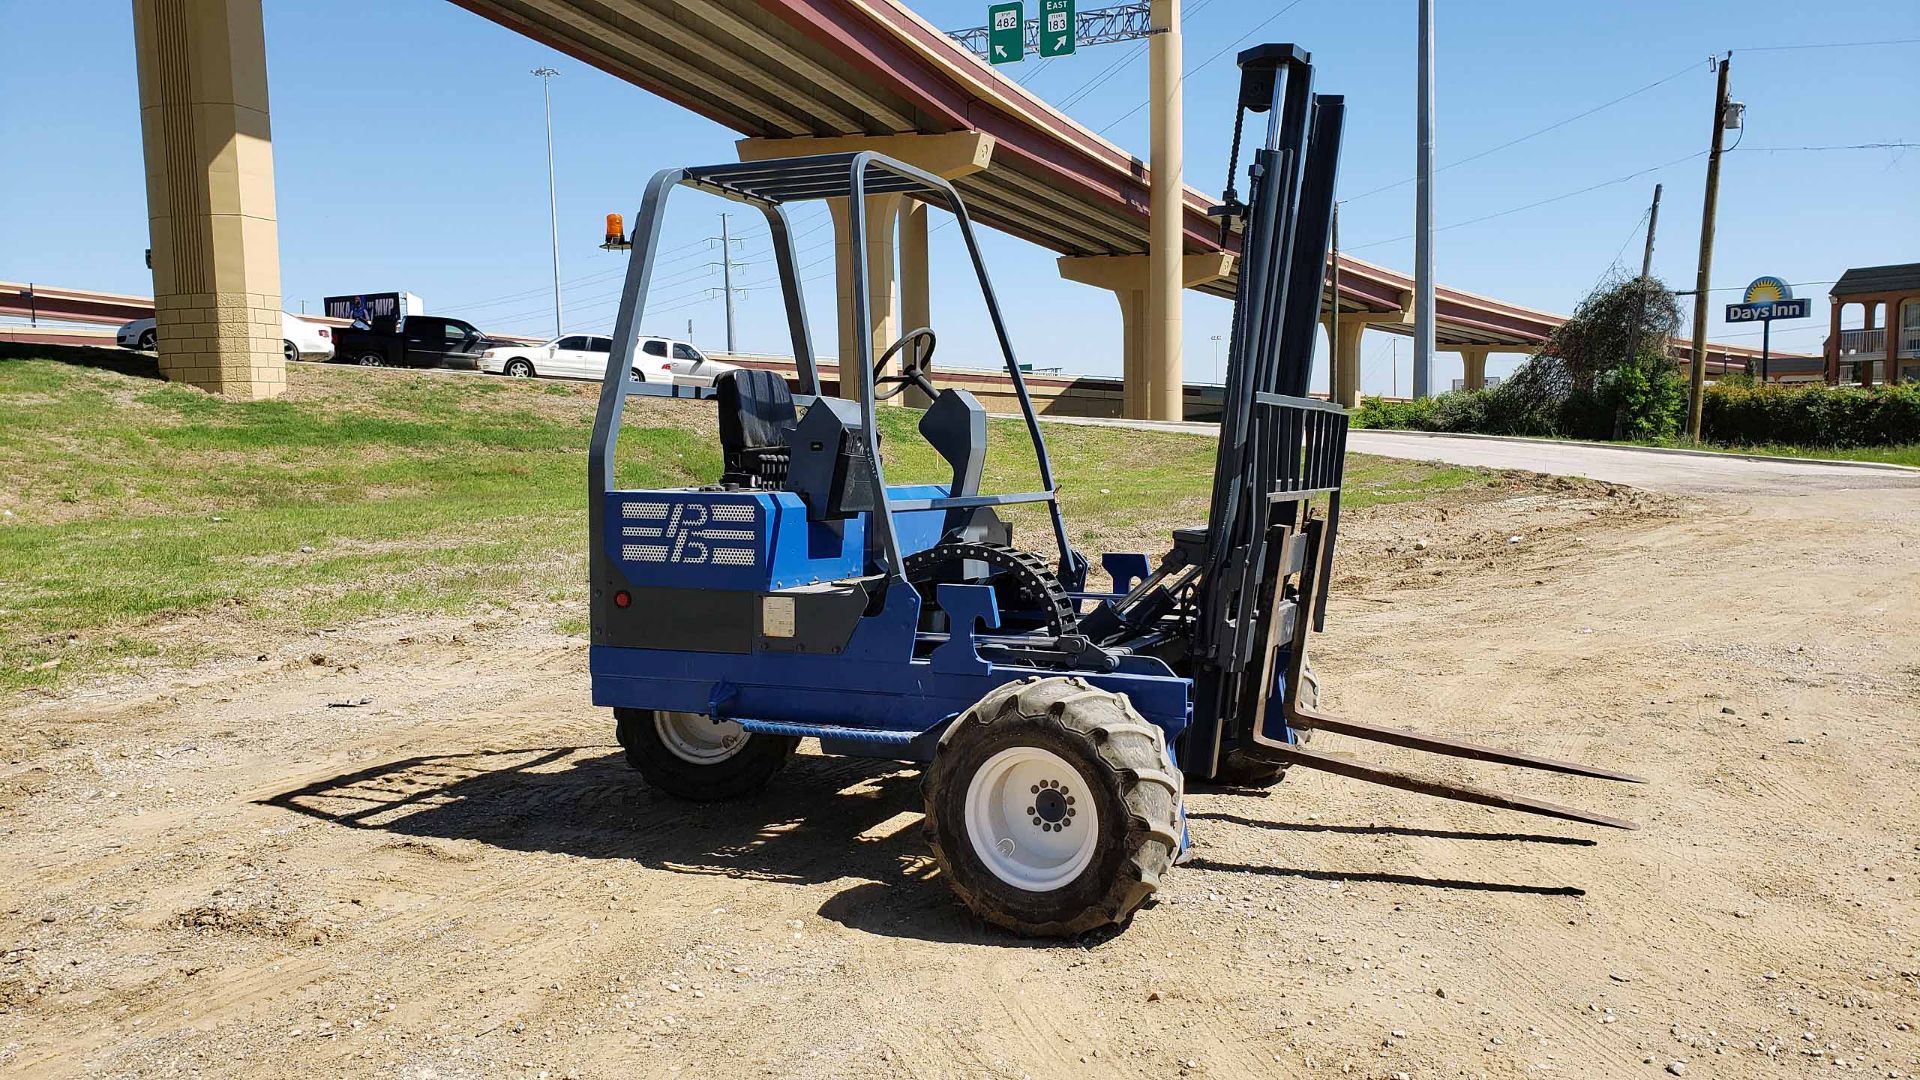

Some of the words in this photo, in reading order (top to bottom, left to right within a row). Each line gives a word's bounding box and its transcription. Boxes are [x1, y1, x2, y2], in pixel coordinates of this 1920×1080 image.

[1046, 1, 1067, 10] EAST
[996, 17, 1016, 28] 482
[1049, 19, 1066, 31] 183
[375, 298, 394, 316] MVP
[1730, 307, 1770, 320] Days
[1772, 304, 1800, 317] Inn
